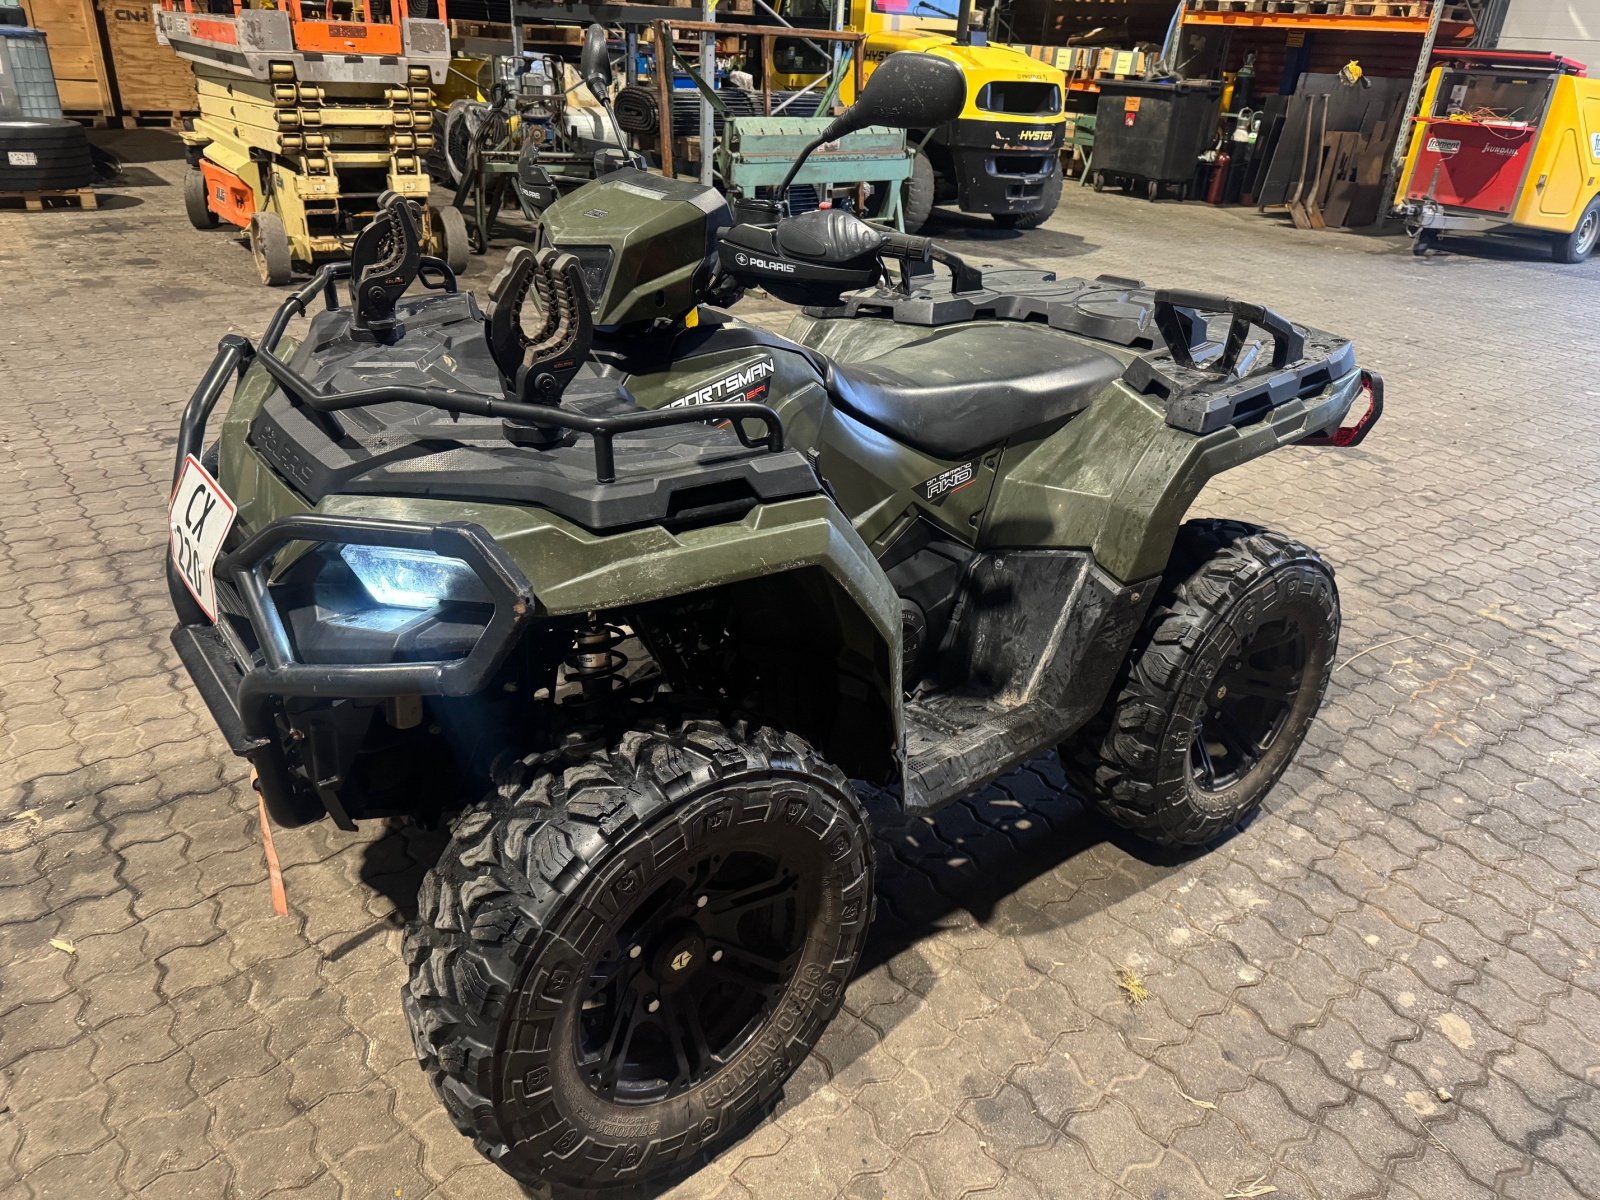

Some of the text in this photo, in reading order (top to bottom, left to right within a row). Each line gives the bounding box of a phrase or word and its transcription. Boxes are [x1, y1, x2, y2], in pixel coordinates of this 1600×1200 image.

[865, 50, 894, 61] HYST
[1019, 130, 1053, 141] HYSTER
[749, 257, 795, 273] POLARIS
[938, 462, 972, 480] DEMAND
[927, 468, 973, 499] AWD
[185, 483, 217, 543] CX
[176, 524, 202, 597] 220
